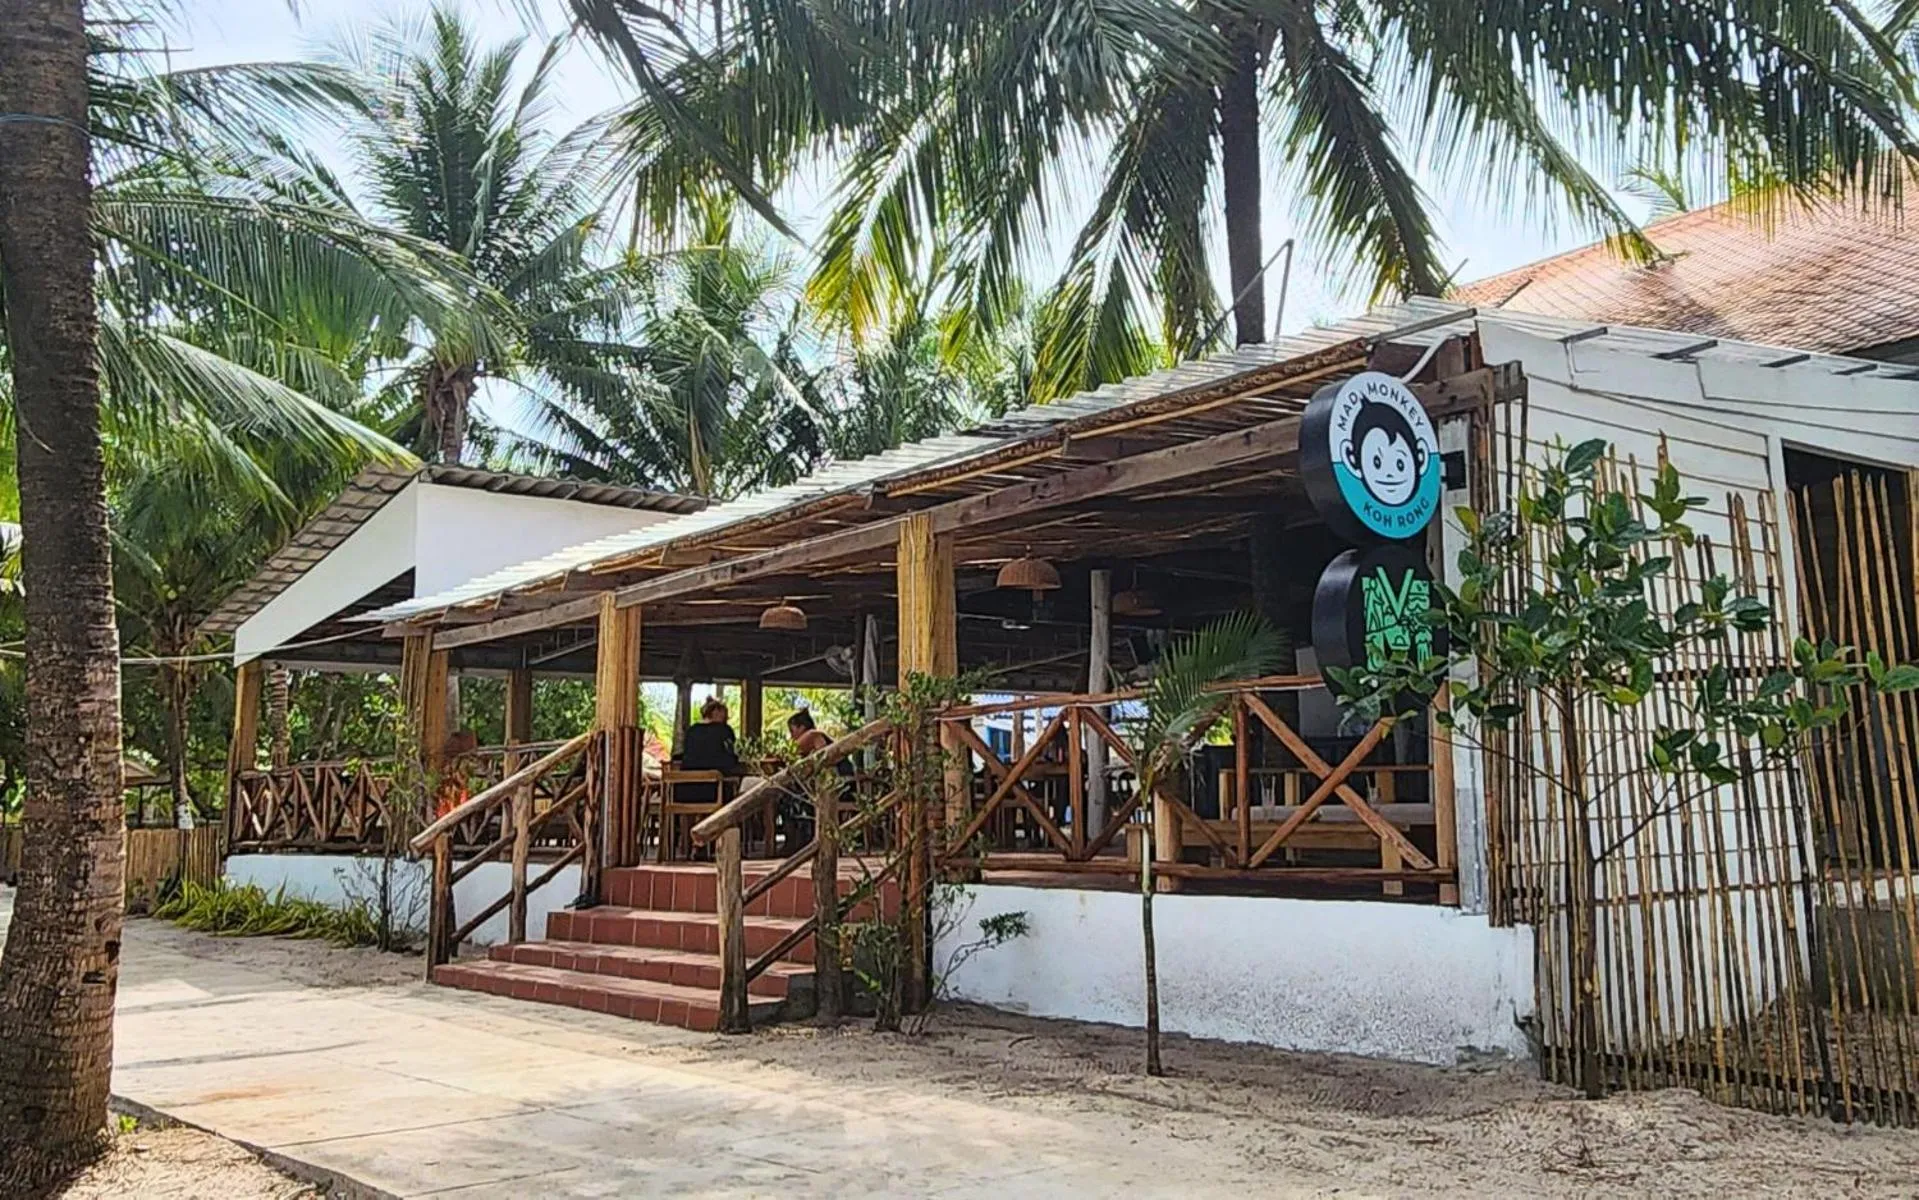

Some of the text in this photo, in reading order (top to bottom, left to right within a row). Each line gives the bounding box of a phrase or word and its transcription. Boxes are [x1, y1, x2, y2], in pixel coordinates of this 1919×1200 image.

[1337, 381, 1425, 432] MAD MONKEY
[1363, 497, 1430, 529] KOH RONG
